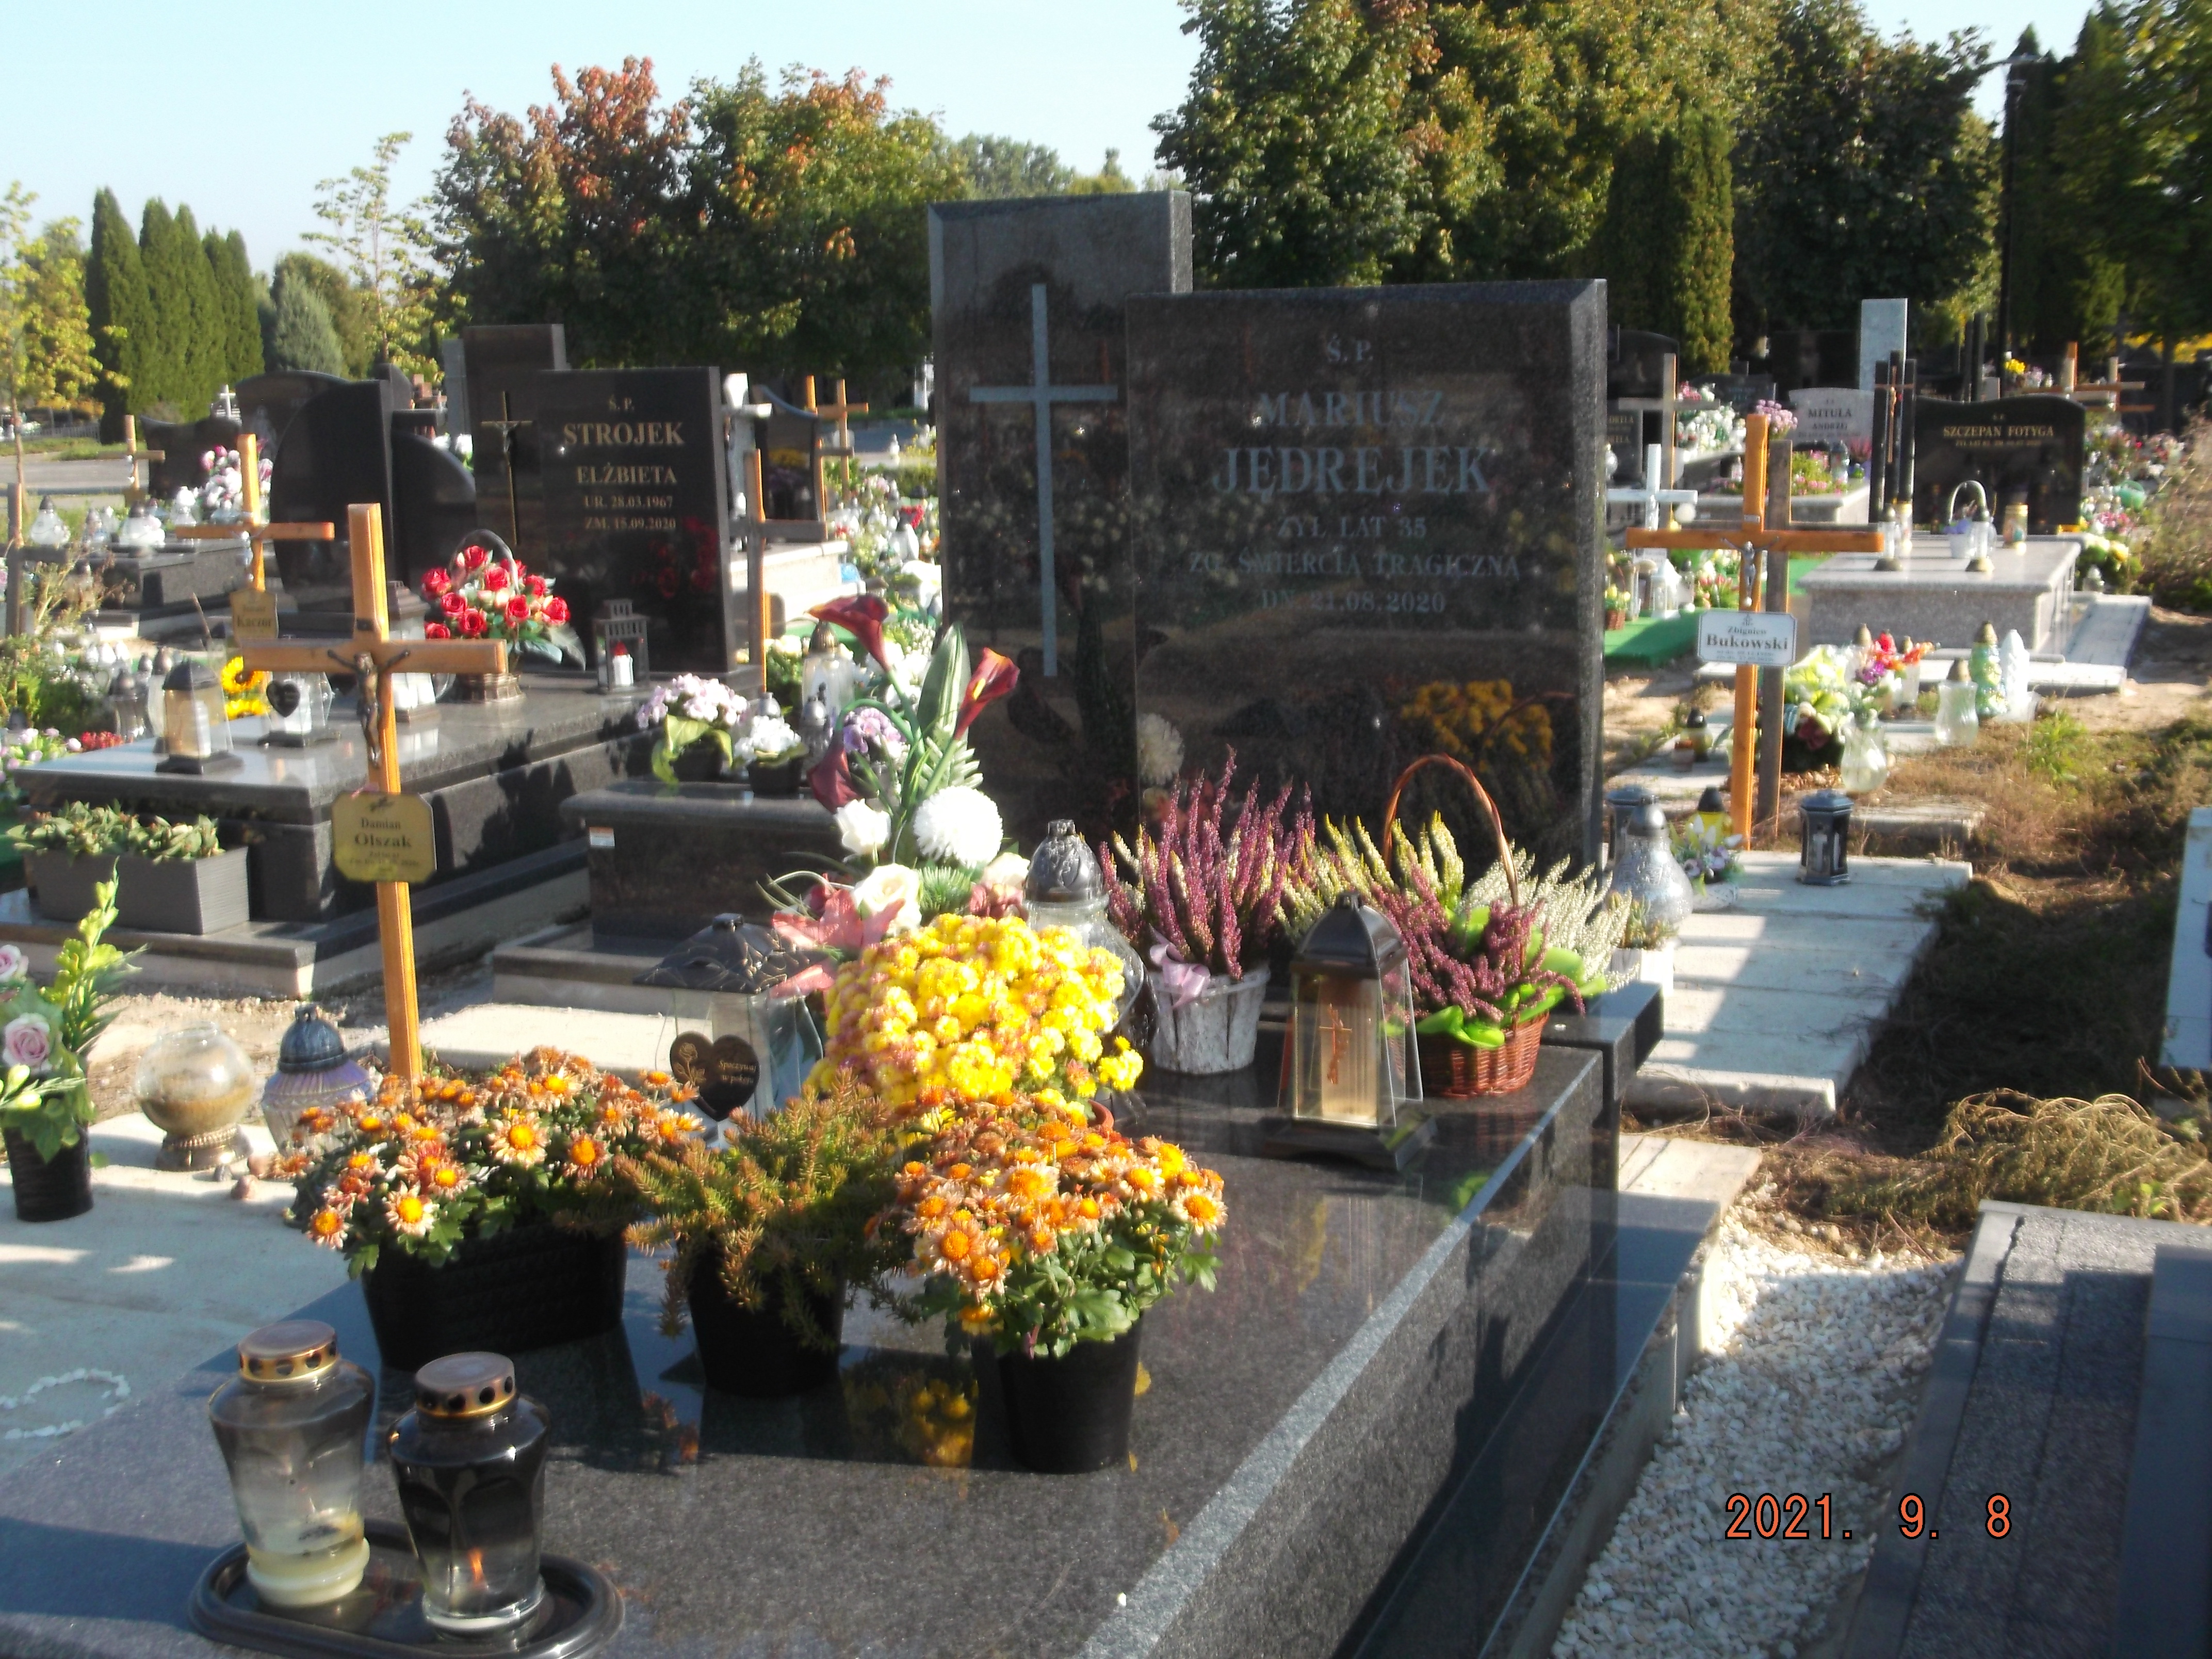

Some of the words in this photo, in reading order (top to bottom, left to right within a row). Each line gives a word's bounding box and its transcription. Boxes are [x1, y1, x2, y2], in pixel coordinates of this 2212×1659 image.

[1259, 390, 1445, 427] MARIUSZ
[562, 421, 686, 447] STROJEK
[1943, 425, 2002, 437] SZCZEPAN
[2007, 425, 2055, 437] FOTYGA
[575, 462, 678, 484] ELŻBIETA
[1211, 444, 1491, 502] JĘDREJEK
[583, 495, 608, 509] UR.
[583, 516, 610, 530] ZM.
[1339, 515, 1387, 539] LAT
[1399, 516, 1427, 539] 35
[1728, 626, 1767, 635] Zbigniew
[1707, 633, 1788, 649] Bukowski
[361, 817, 401, 831] Damian
[354, 832, 412, 849] Olszak
[719, 1060, 756, 1073] Spoczywaj
